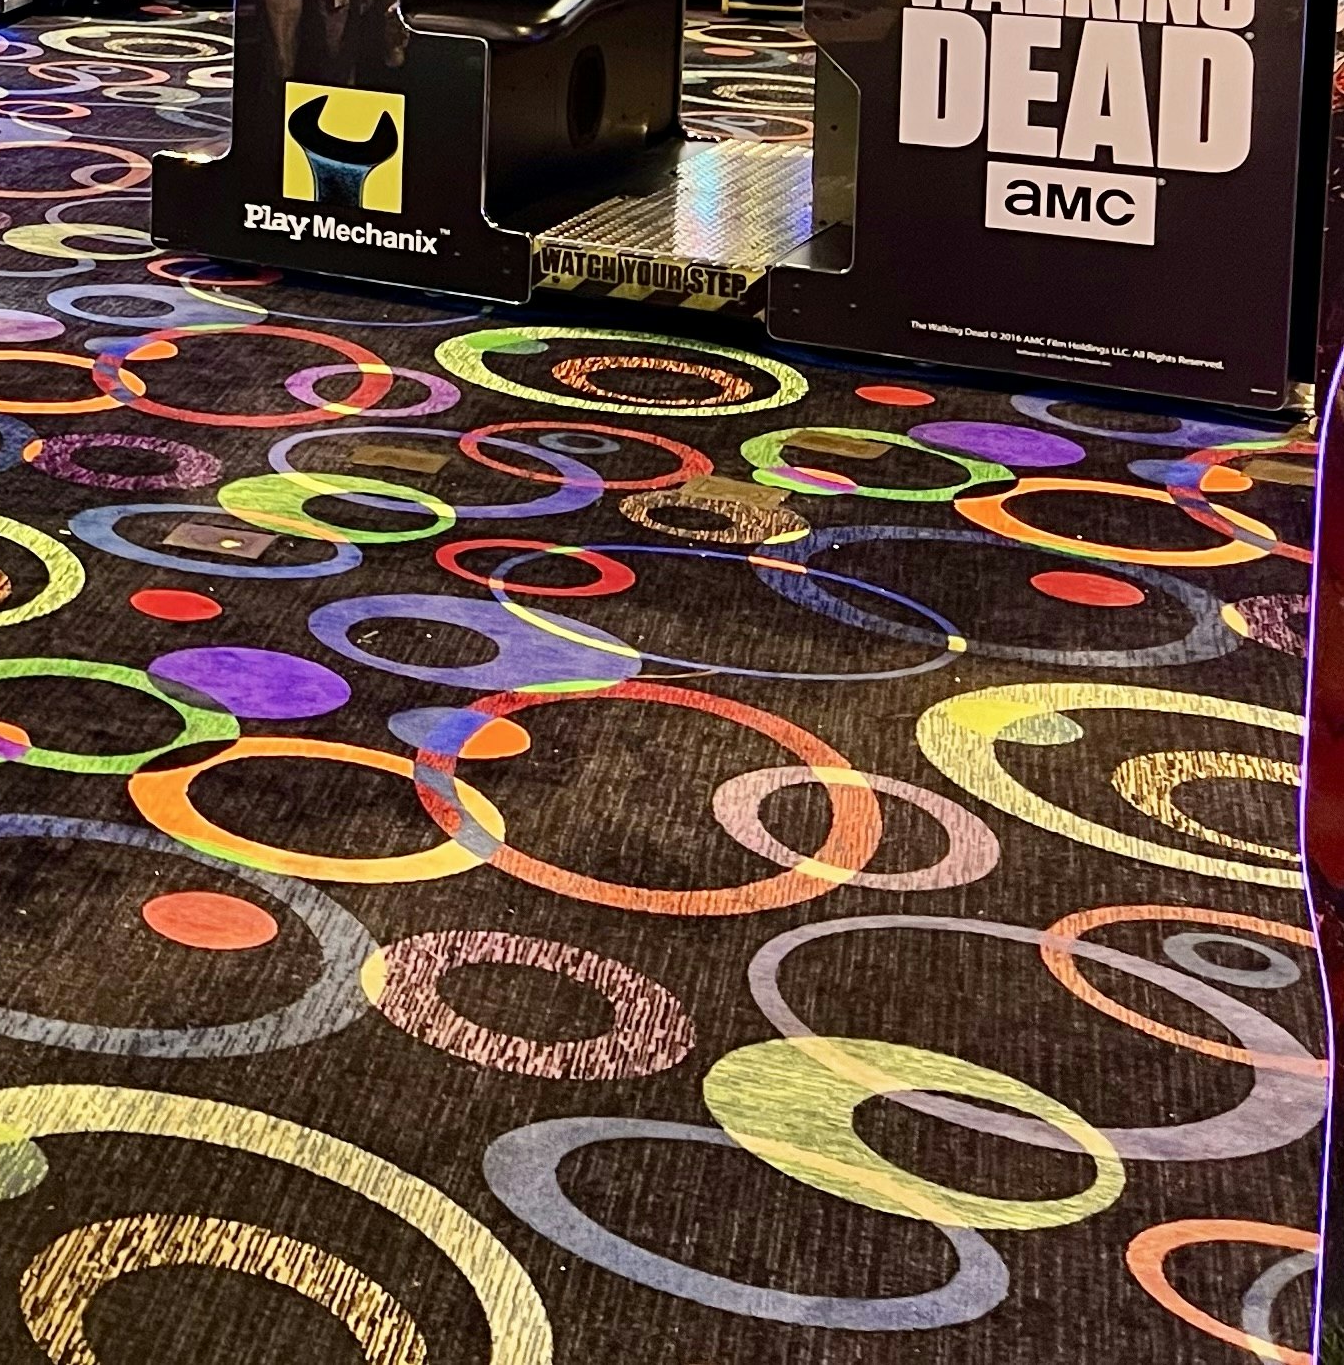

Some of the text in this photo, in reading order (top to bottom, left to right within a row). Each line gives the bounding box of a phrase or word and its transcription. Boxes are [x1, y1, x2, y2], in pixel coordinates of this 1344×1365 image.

[898, 7, 1255, 173] DEAD
[243, 203, 310, 241] Play
[540, 245, 747, 299] WATCH YOUR STEP
[911, 320, 926, 331] The
[928, 322, 963, 336] Walking
[964, 327, 988, 339] Dead
[1023, 335, 1045, 346] AMC
[1047, 338, 1066, 349] Film
[1068, 341, 1110, 355] Holdings
[1132, 349, 1145, 359] All
[1146, 351, 1176, 364] Rights
